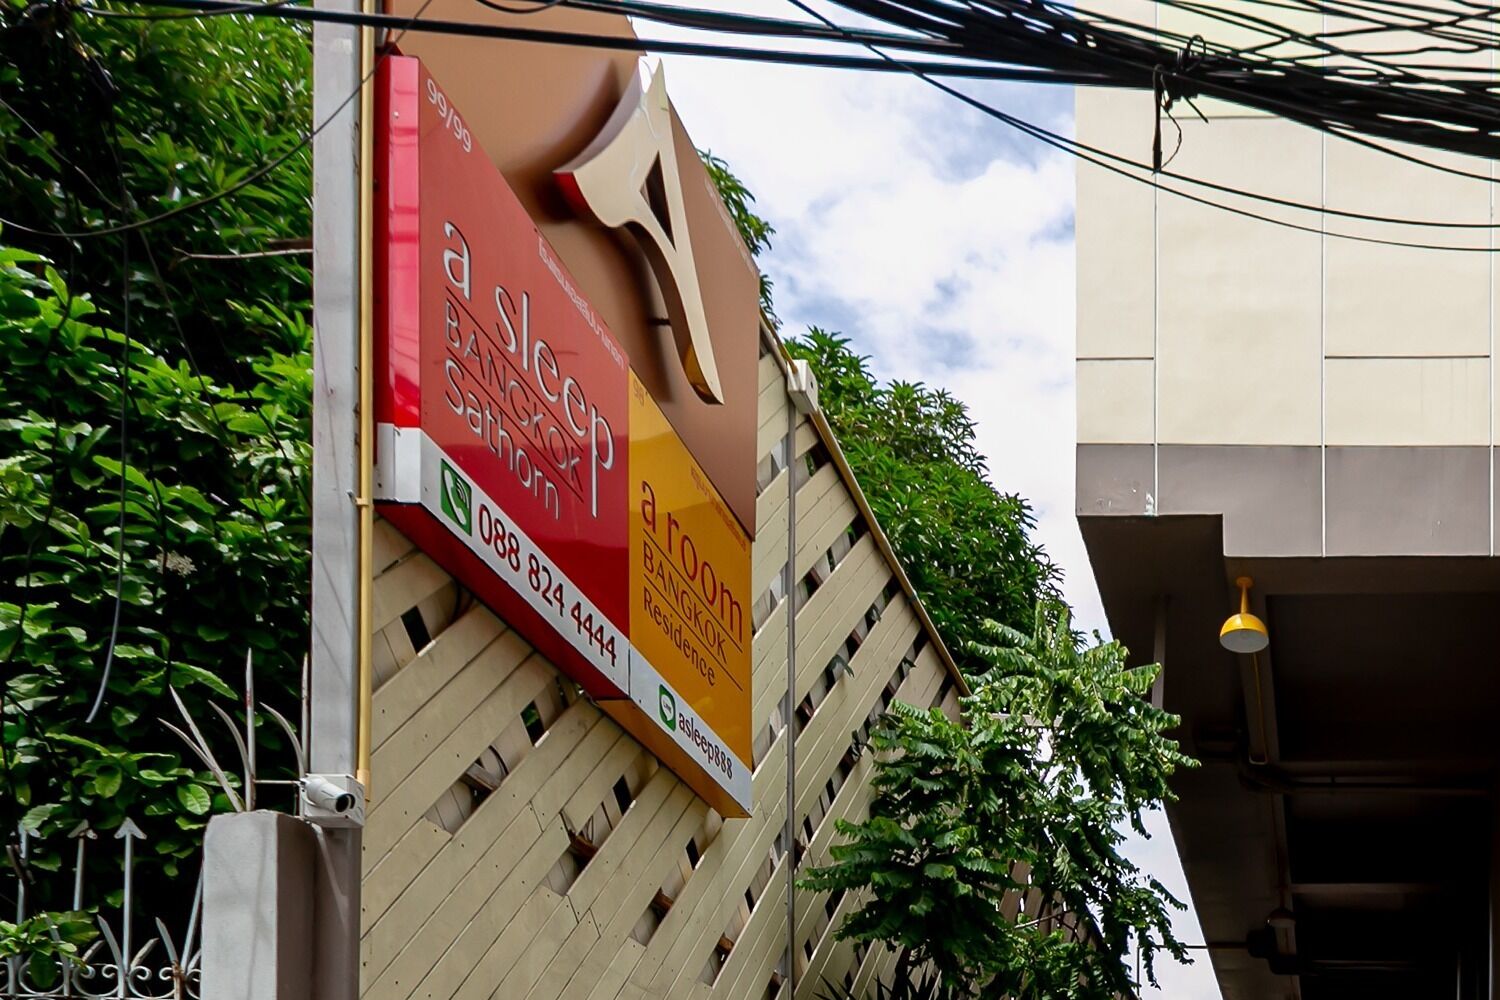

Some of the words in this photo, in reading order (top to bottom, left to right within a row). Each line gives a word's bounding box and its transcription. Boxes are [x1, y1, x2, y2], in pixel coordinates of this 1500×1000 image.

[427, 78, 472, 152] 99/99
[443, 221, 471, 299] a
[495, 285, 614, 518] sleep
[445, 359, 559, 520] Sathorn
[446, 299, 583, 492] BANGKOK
[478, 503, 521, 573] 088
[528, 553, 565, 617] 824
[571, 601, 616, 667] 4444
[641, 480, 656, 533] a
[667, 512, 742, 643] room
[643, 540, 727, 664] BANGKOK
[643, 585, 715, 687] Residence
[678, 712, 733, 780] asleep888
